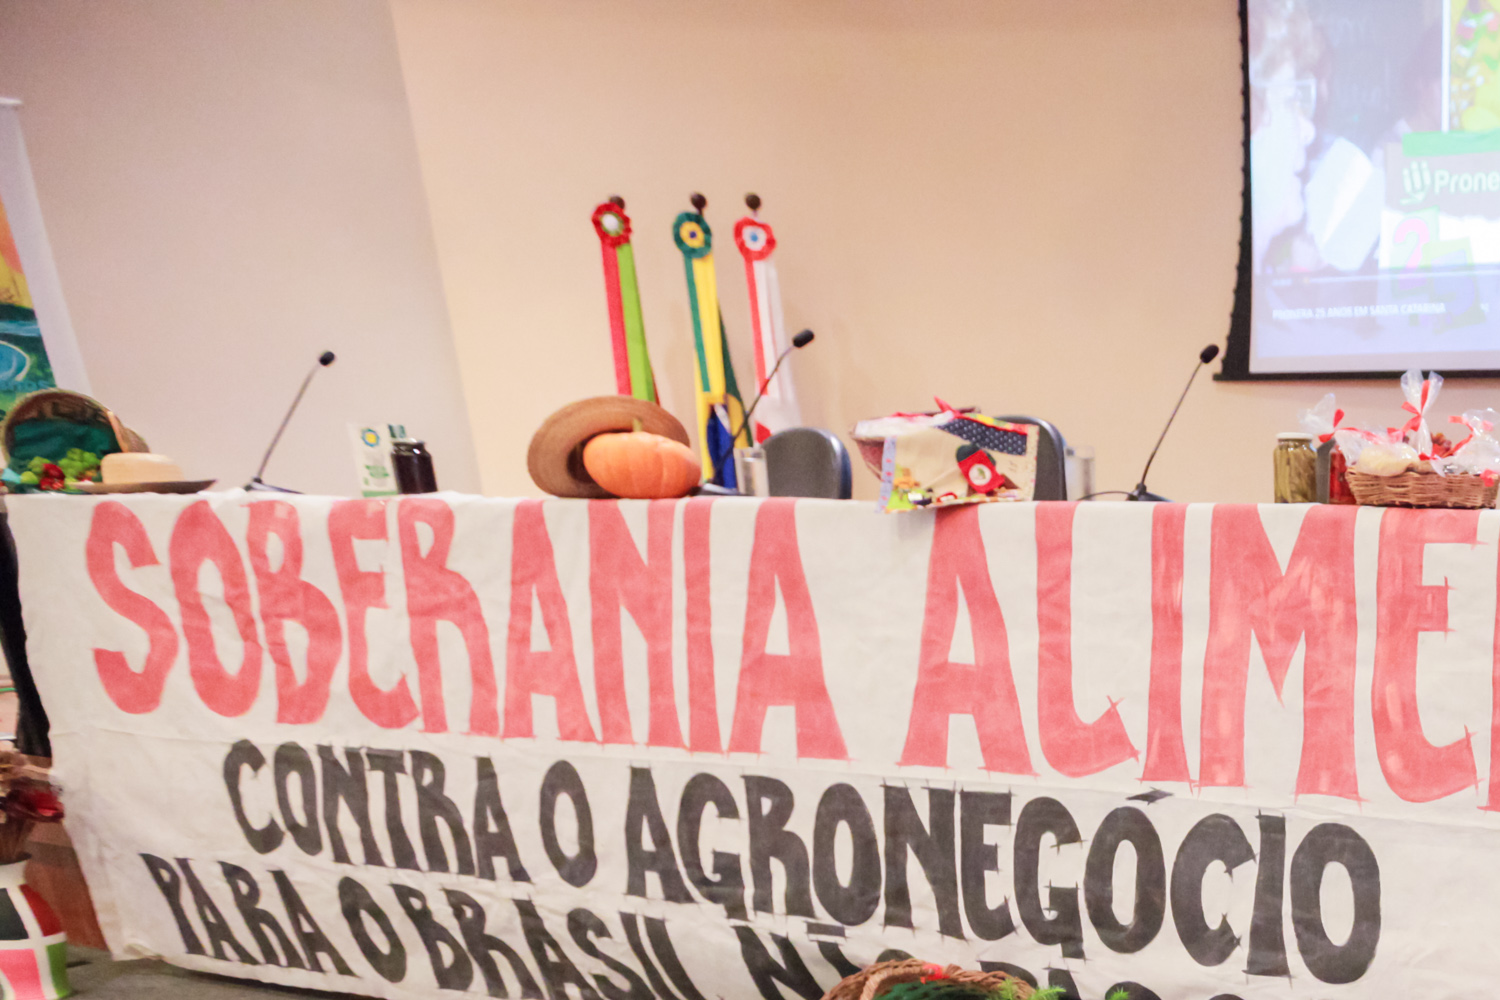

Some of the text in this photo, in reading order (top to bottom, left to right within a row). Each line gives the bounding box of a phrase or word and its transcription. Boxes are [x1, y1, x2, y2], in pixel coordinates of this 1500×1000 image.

[86, 497, 852, 762] SOBERANIA
[140, 852, 358, 978] PARA
[337, 876, 408, 983] O
[222, 737, 530, 884] CONTRA
[538, 759, 599, 889] O
[623, 764, 1383, 986] AGRONEGÓCIO
